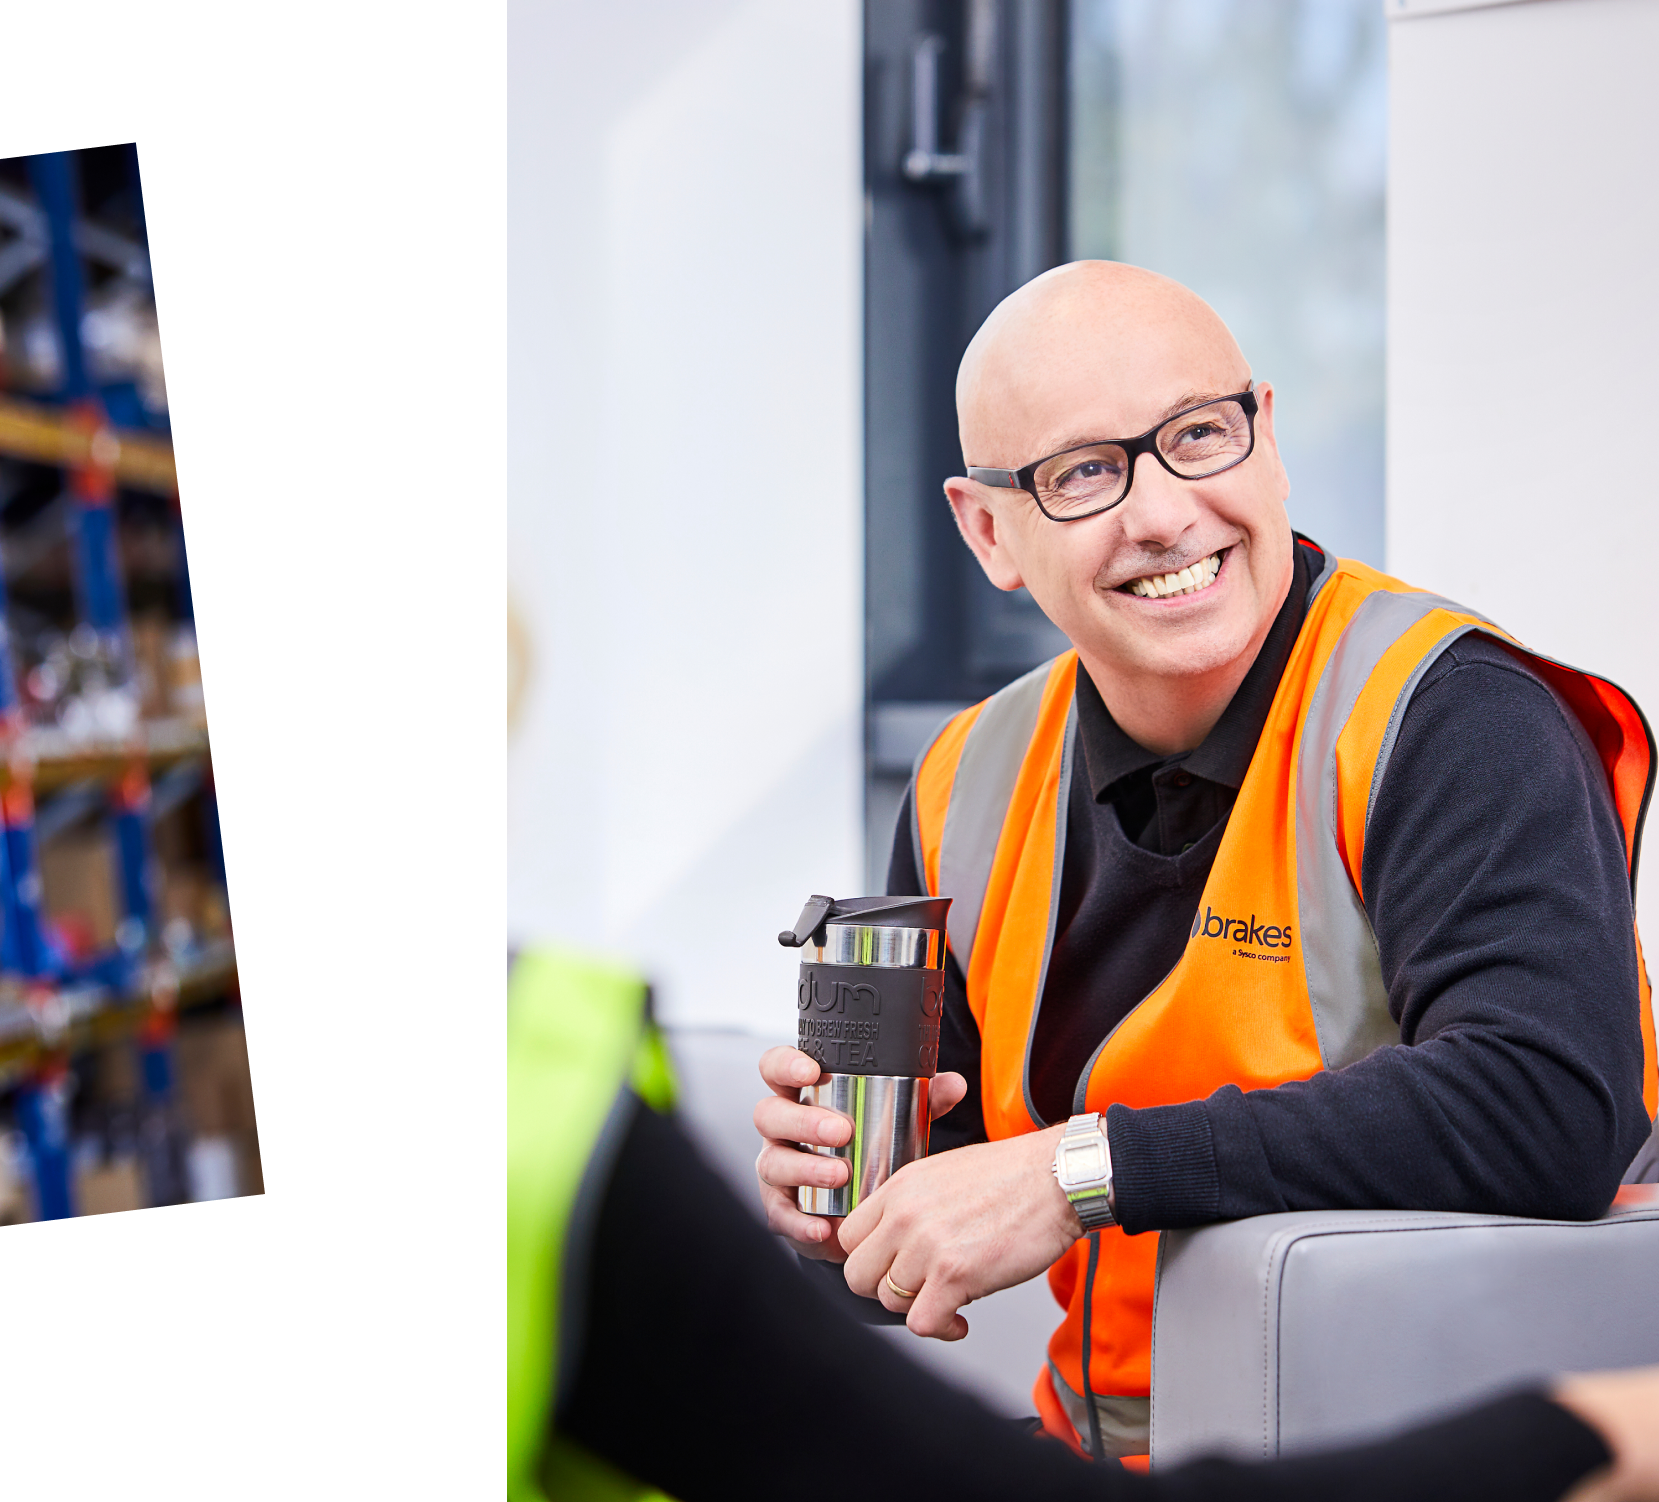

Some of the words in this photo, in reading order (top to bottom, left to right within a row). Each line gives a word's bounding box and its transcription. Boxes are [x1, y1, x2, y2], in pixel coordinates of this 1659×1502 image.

[1201, 906, 1292, 948] brakes
[1238, 948, 1257, 959] Sysco
[1257, 953, 1292, 963] company
[816, 1019, 842, 1039] BREW
[843, 1021, 880, 1041] FRESH
[813, 1038, 827, 1065] &
[830, 1039, 879, 1068] TEA
